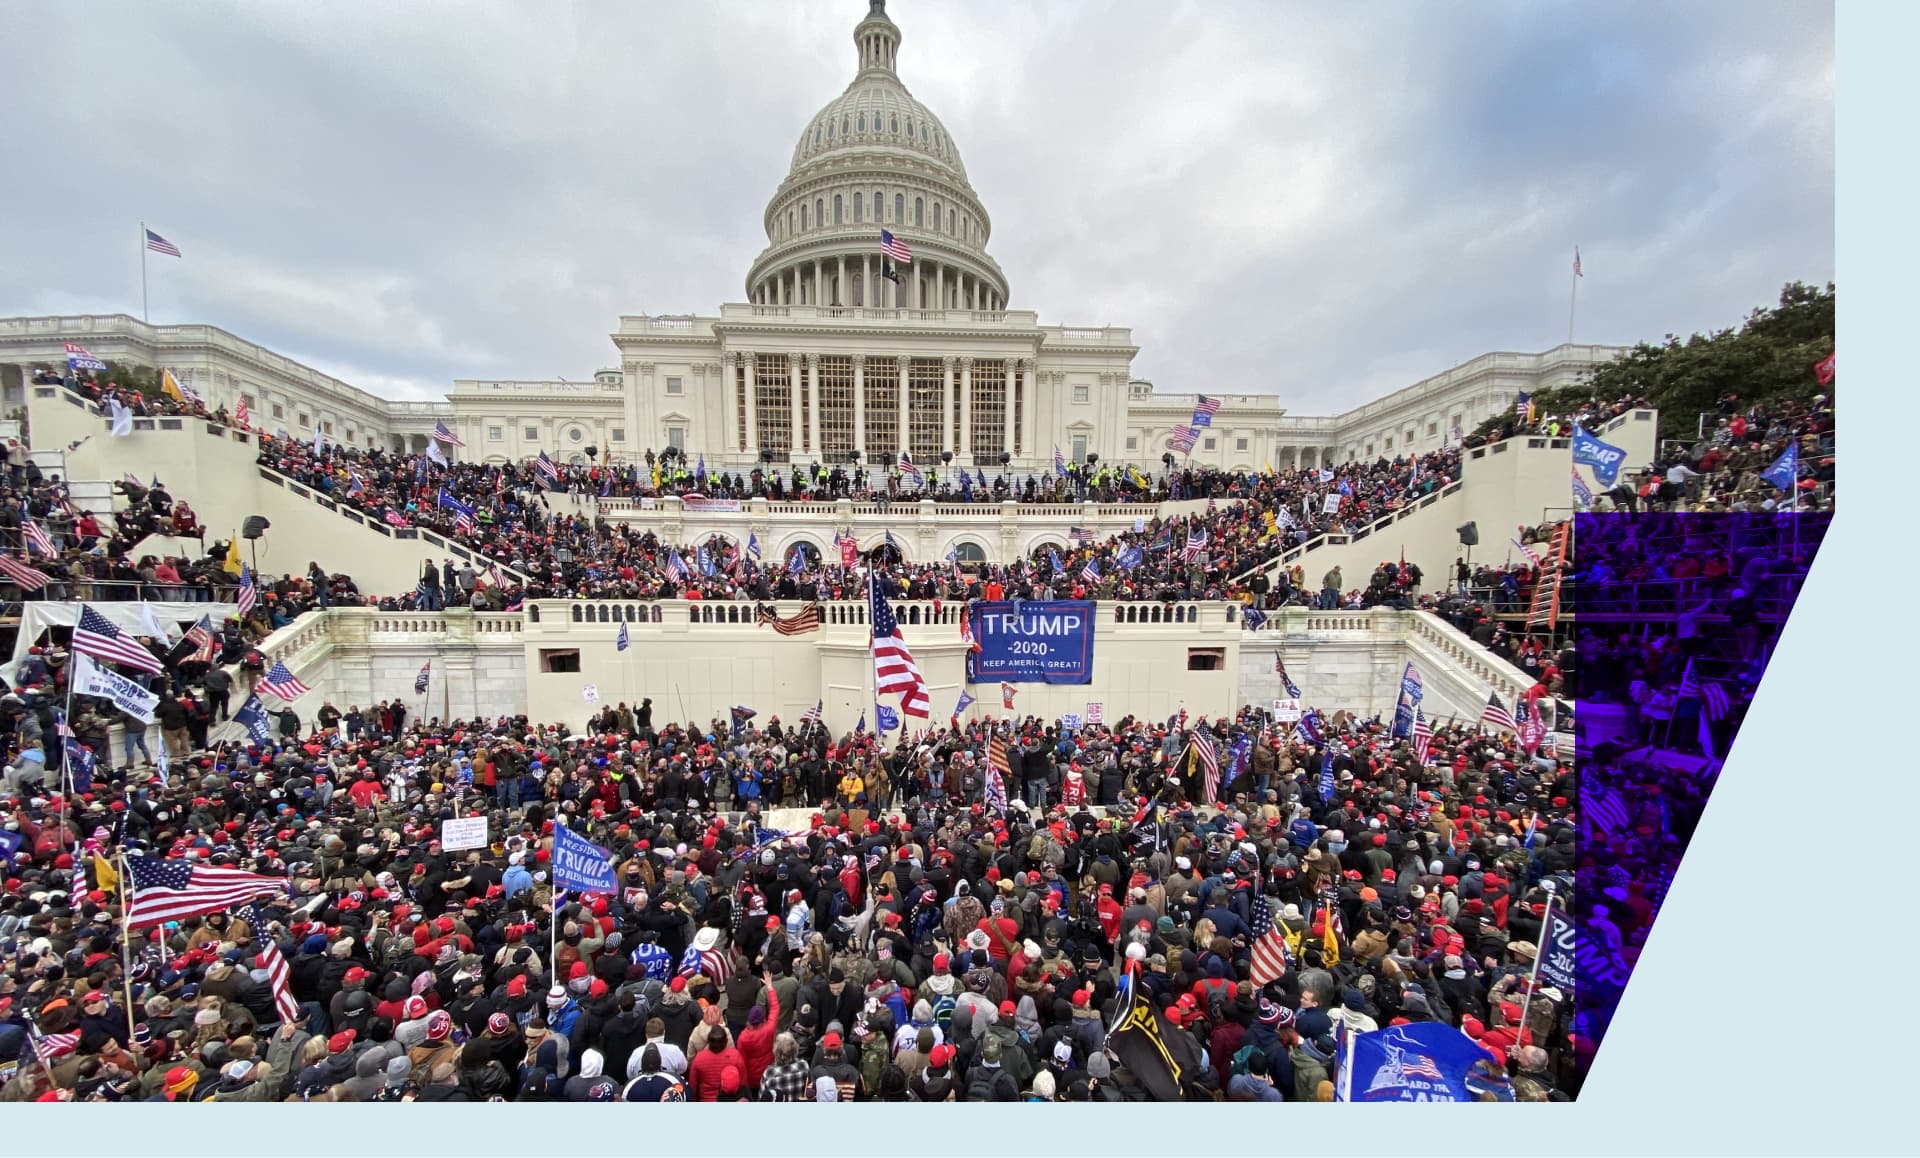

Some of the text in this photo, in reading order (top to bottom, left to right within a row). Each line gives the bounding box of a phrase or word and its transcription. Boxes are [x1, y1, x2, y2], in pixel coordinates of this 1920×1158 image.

[982, 613, 1081, 636] TRUMP
[983, 659, 1081, 669] KEEP AMERICA GREAT!
[556, 847, 609, 878] TRUMP
